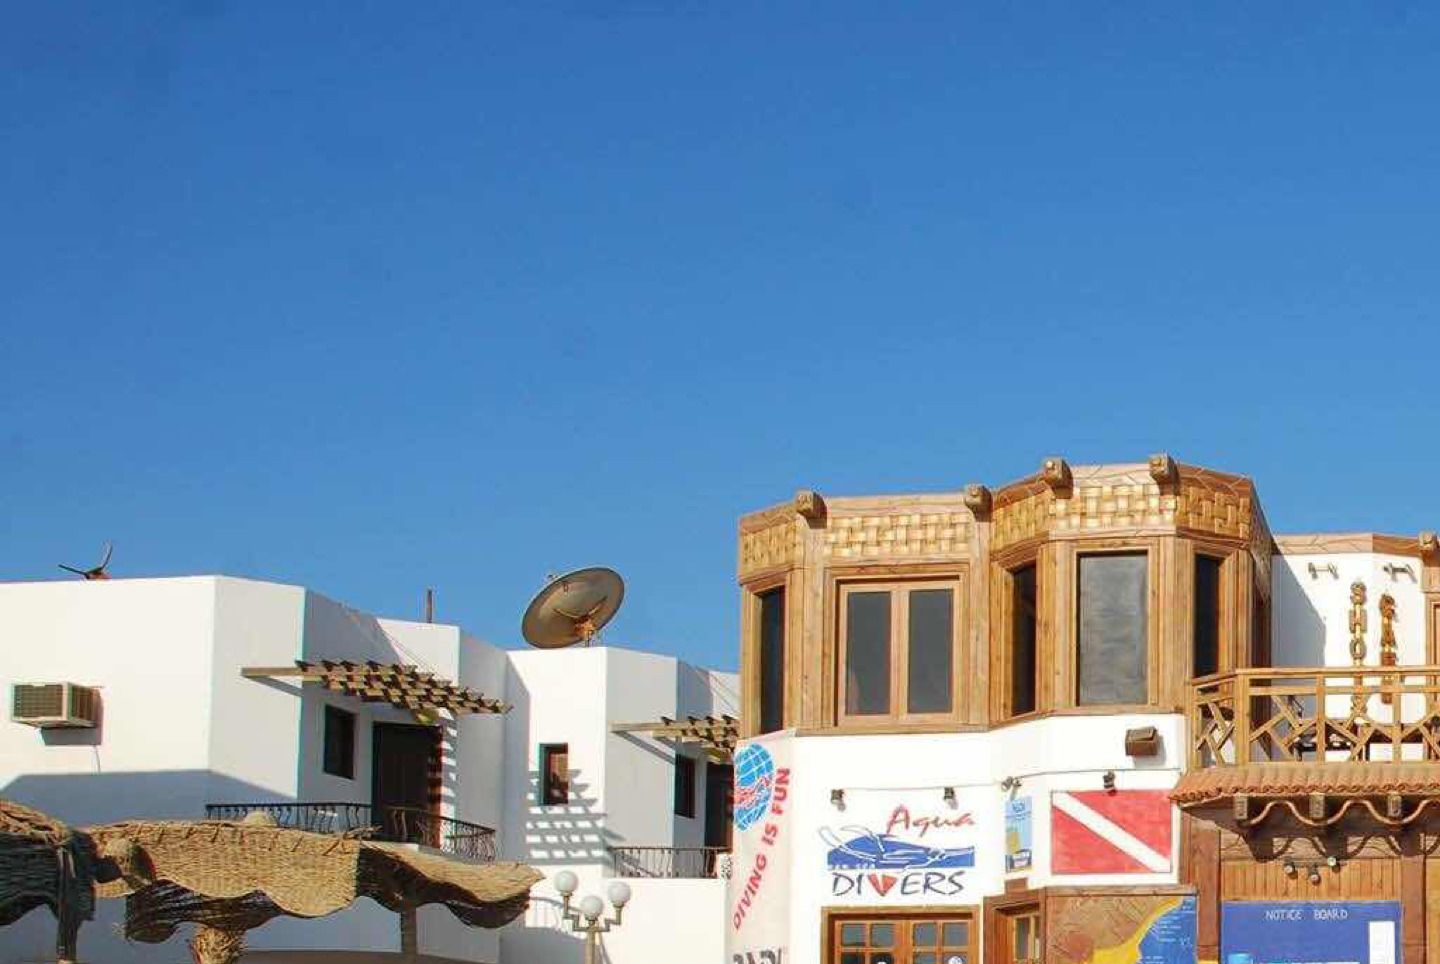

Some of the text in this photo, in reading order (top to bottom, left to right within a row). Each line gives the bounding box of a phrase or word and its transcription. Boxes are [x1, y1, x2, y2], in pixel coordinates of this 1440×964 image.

[886, 804, 976, 837] Aqua
[733, 768, 791, 931] DIVING IS FUN
[832, 871, 966, 897] DIVERS
[1265, 908, 1348, 921] NOTICE BOARD
